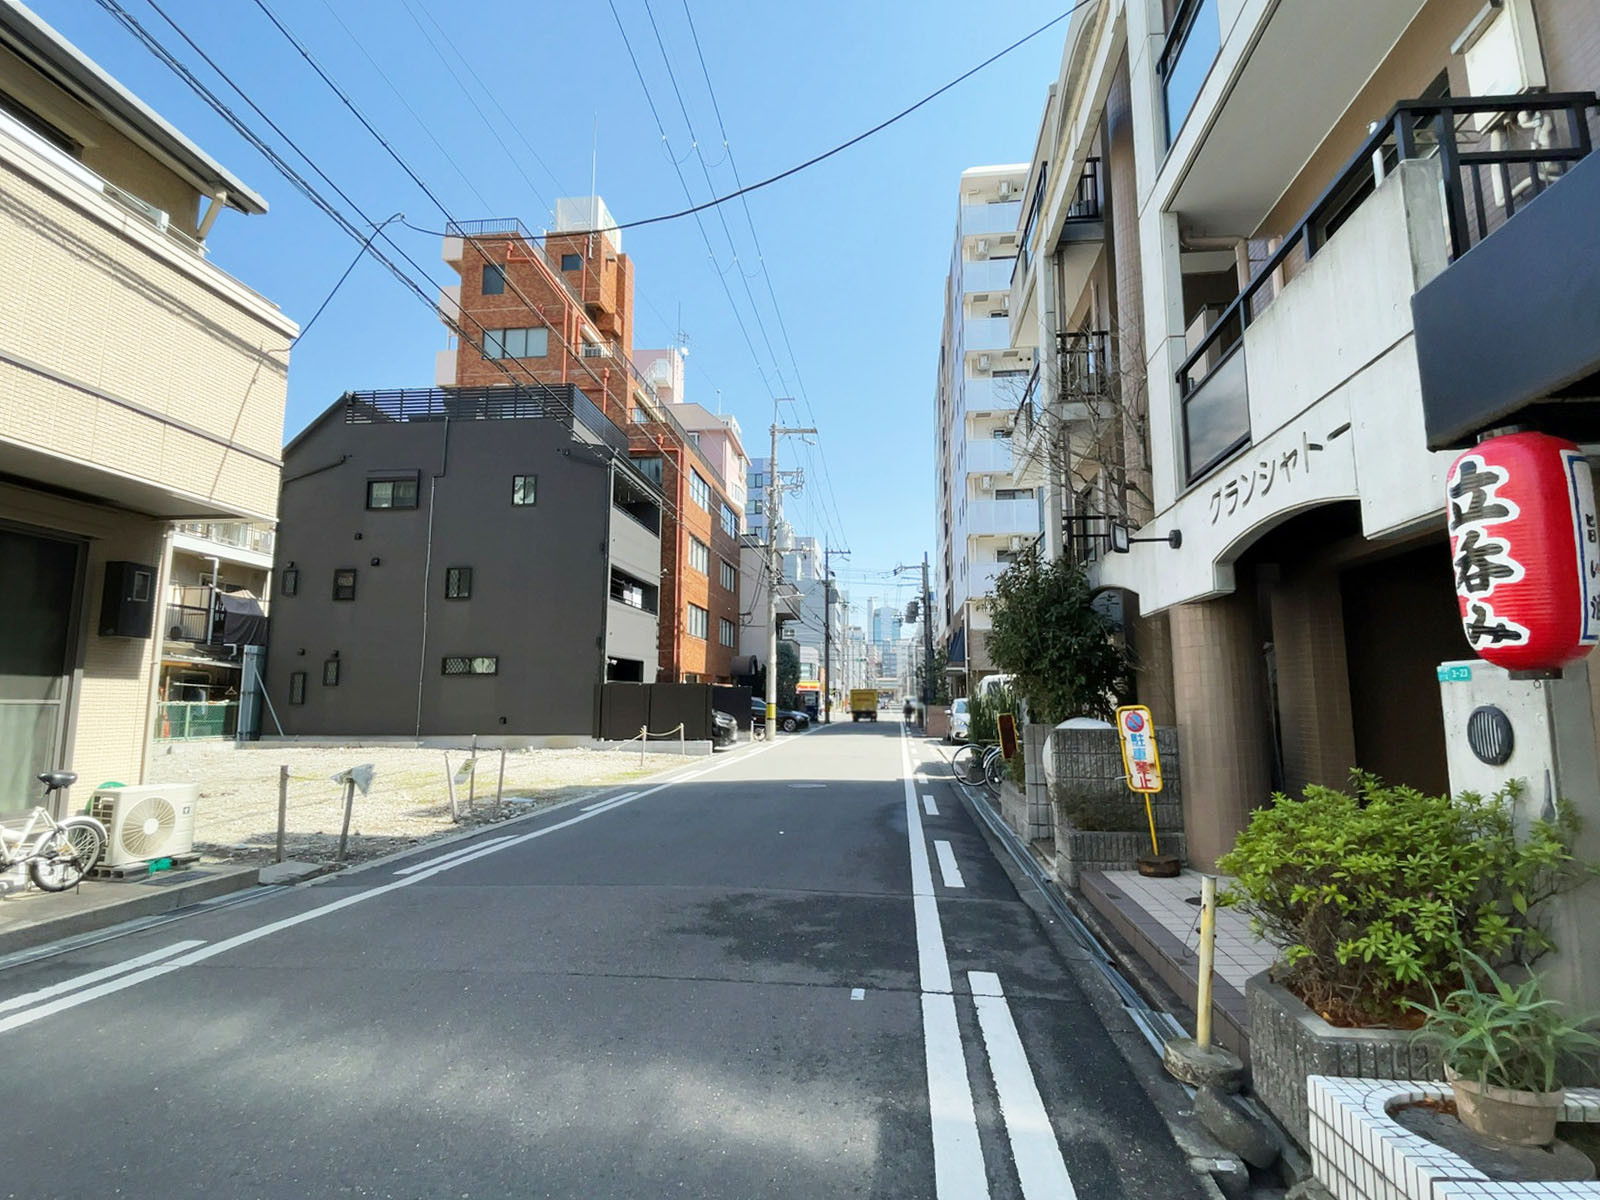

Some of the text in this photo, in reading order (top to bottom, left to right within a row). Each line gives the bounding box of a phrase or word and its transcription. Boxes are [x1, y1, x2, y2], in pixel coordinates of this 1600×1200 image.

[1209, 422, 1351, 526] グランシャトー
[1450, 460, 1522, 645] 立呑み
[1130, 733, 1155, 789] 駐車禁止
